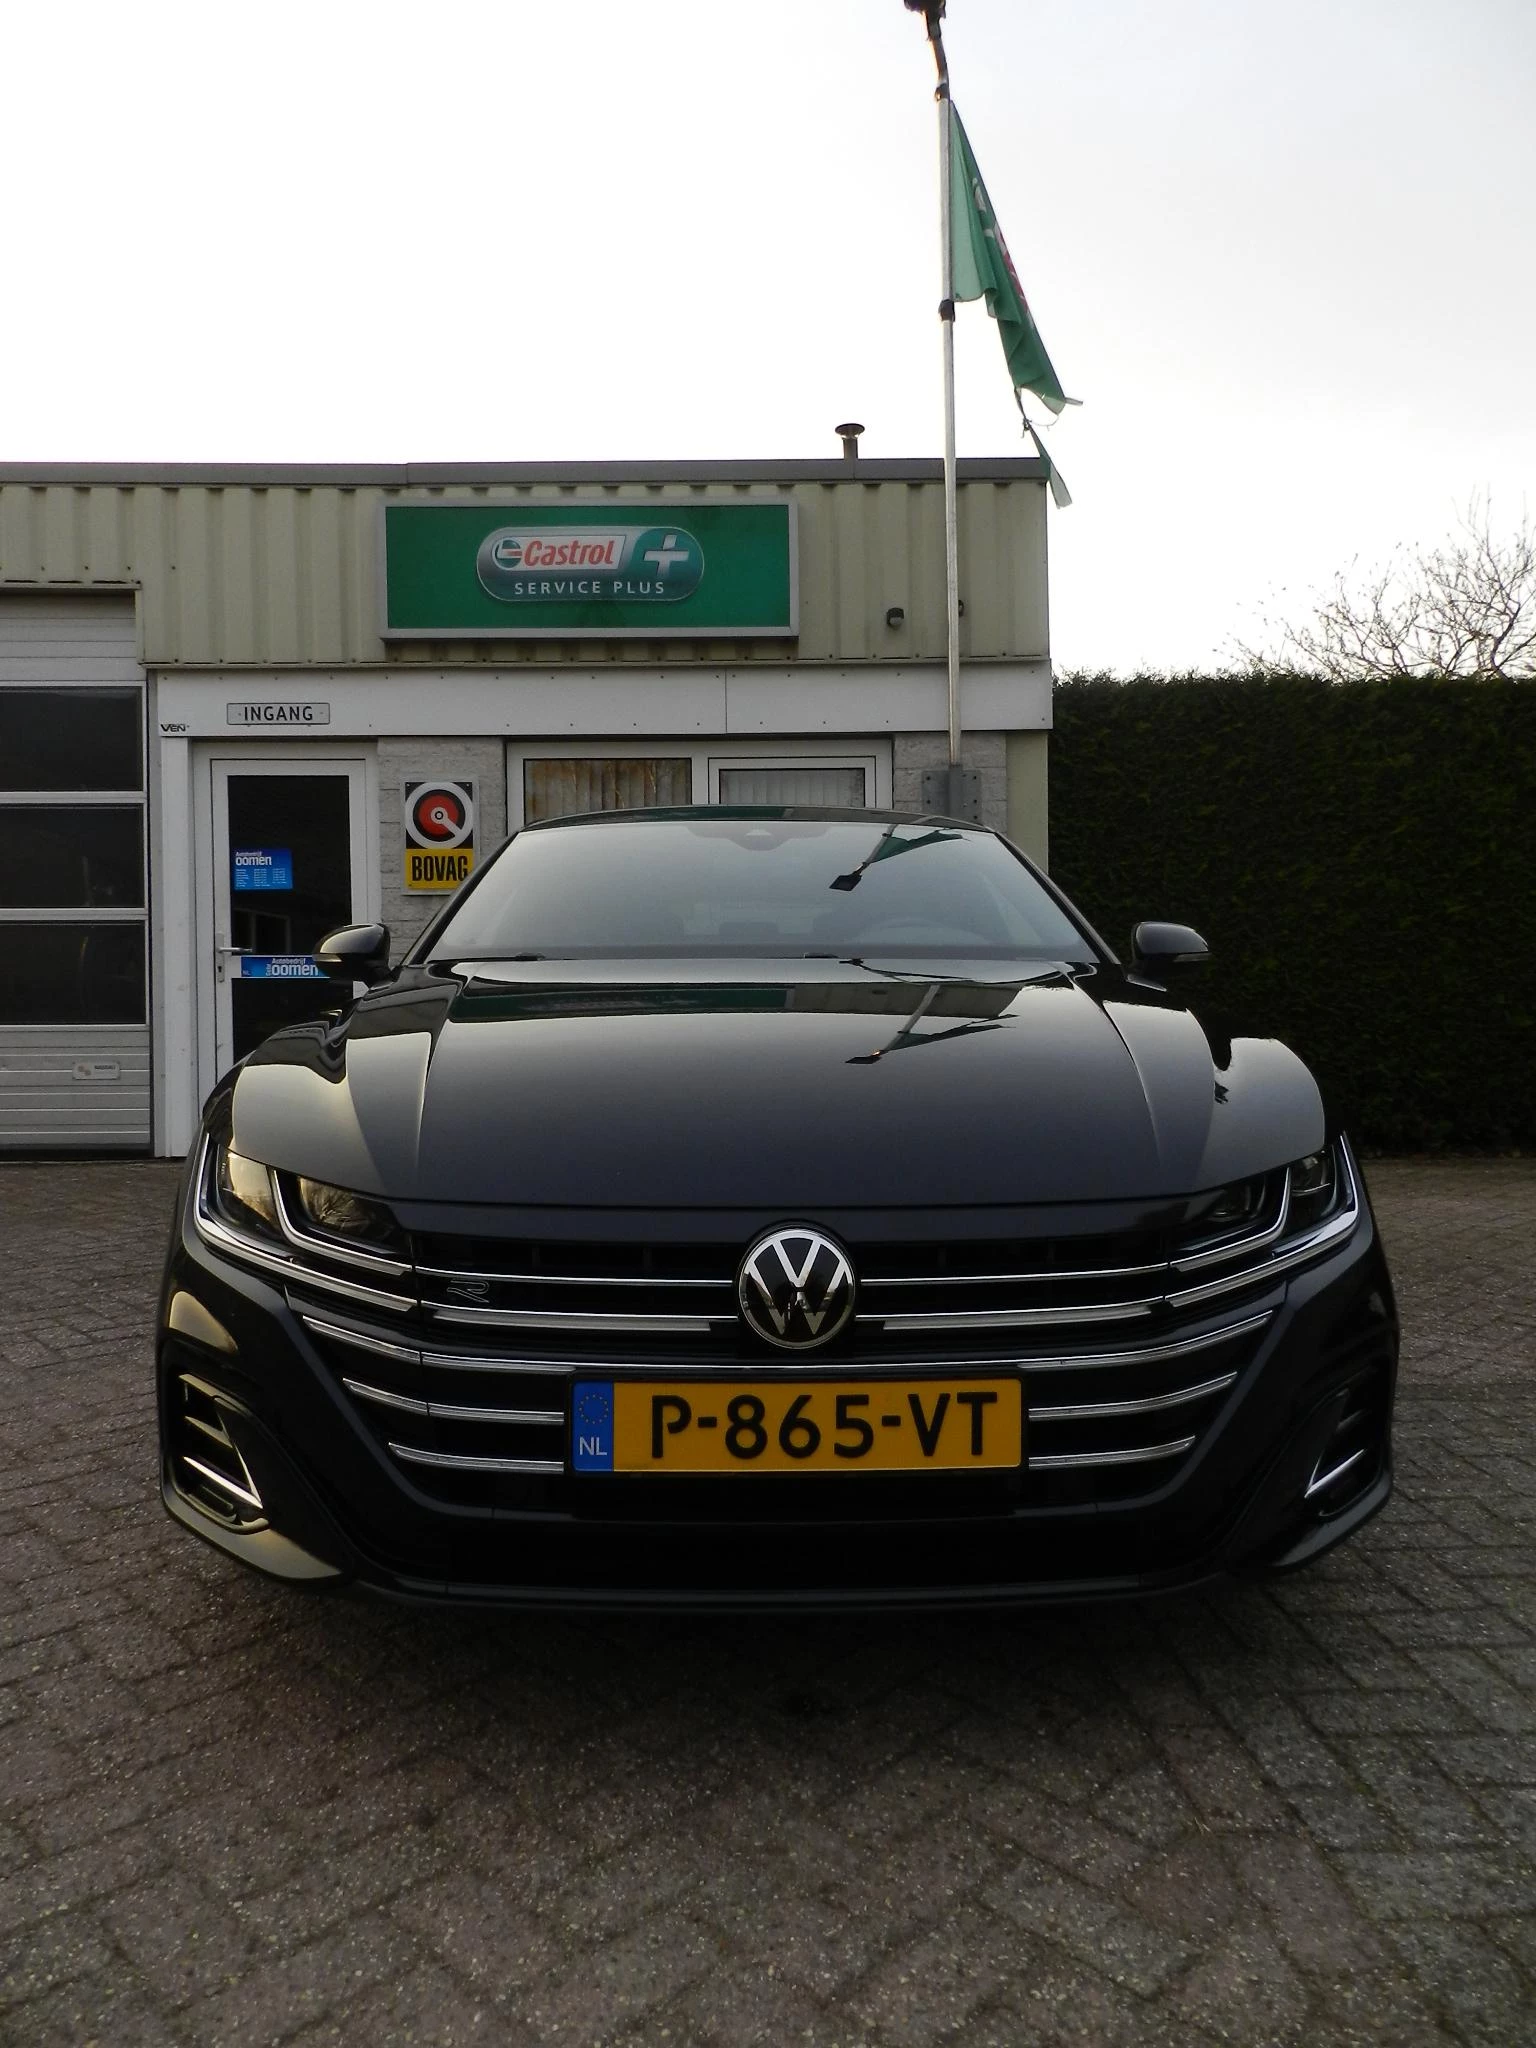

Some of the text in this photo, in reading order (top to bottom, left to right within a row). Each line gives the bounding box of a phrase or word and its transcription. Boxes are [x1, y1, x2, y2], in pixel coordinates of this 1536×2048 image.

[523, 539, 615, 567] Castrol
[514, 581, 665, 595] SERVICE PLUS
[243, 705, 314, 722] INGANG
[235, 856, 273, 866] oomen
[411, 855, 469, 882] BOVAG
[271, 964, 319, 976] oomen
[650, 1391, 999, 1460] P-865-VT
[578, 1436, 608, 1457] NL
